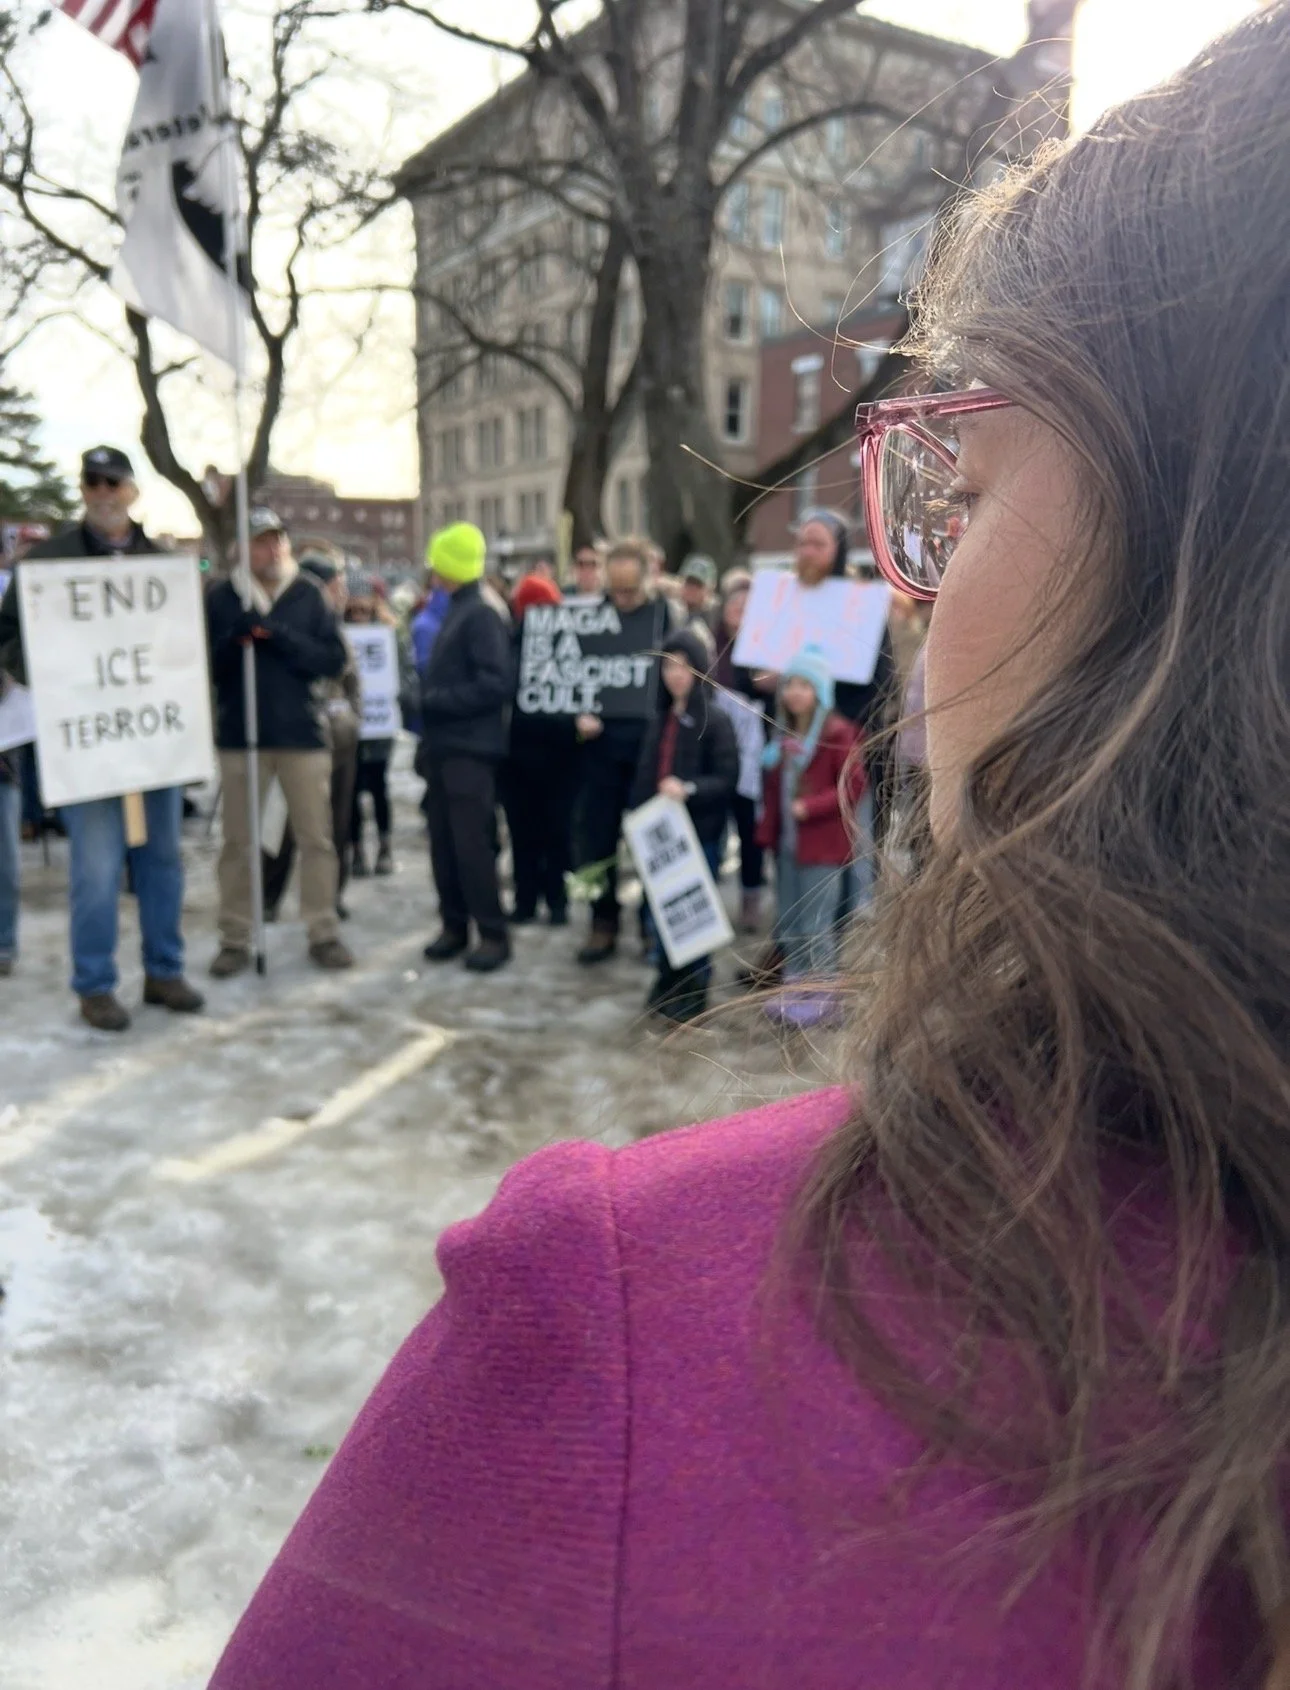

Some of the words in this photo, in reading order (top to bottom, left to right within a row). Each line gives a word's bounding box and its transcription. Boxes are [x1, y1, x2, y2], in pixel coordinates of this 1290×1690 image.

[66, 576, 168, 621] END
[523, 605, 622, 635] MAGA
[522, 635, 553, 660] IS
[555, 634, 582, 659] A
[95, 645, 152, 689] ICE
[520, 655, 654, 688] FASCIST
[59, 700, 185, 748] TERROR
